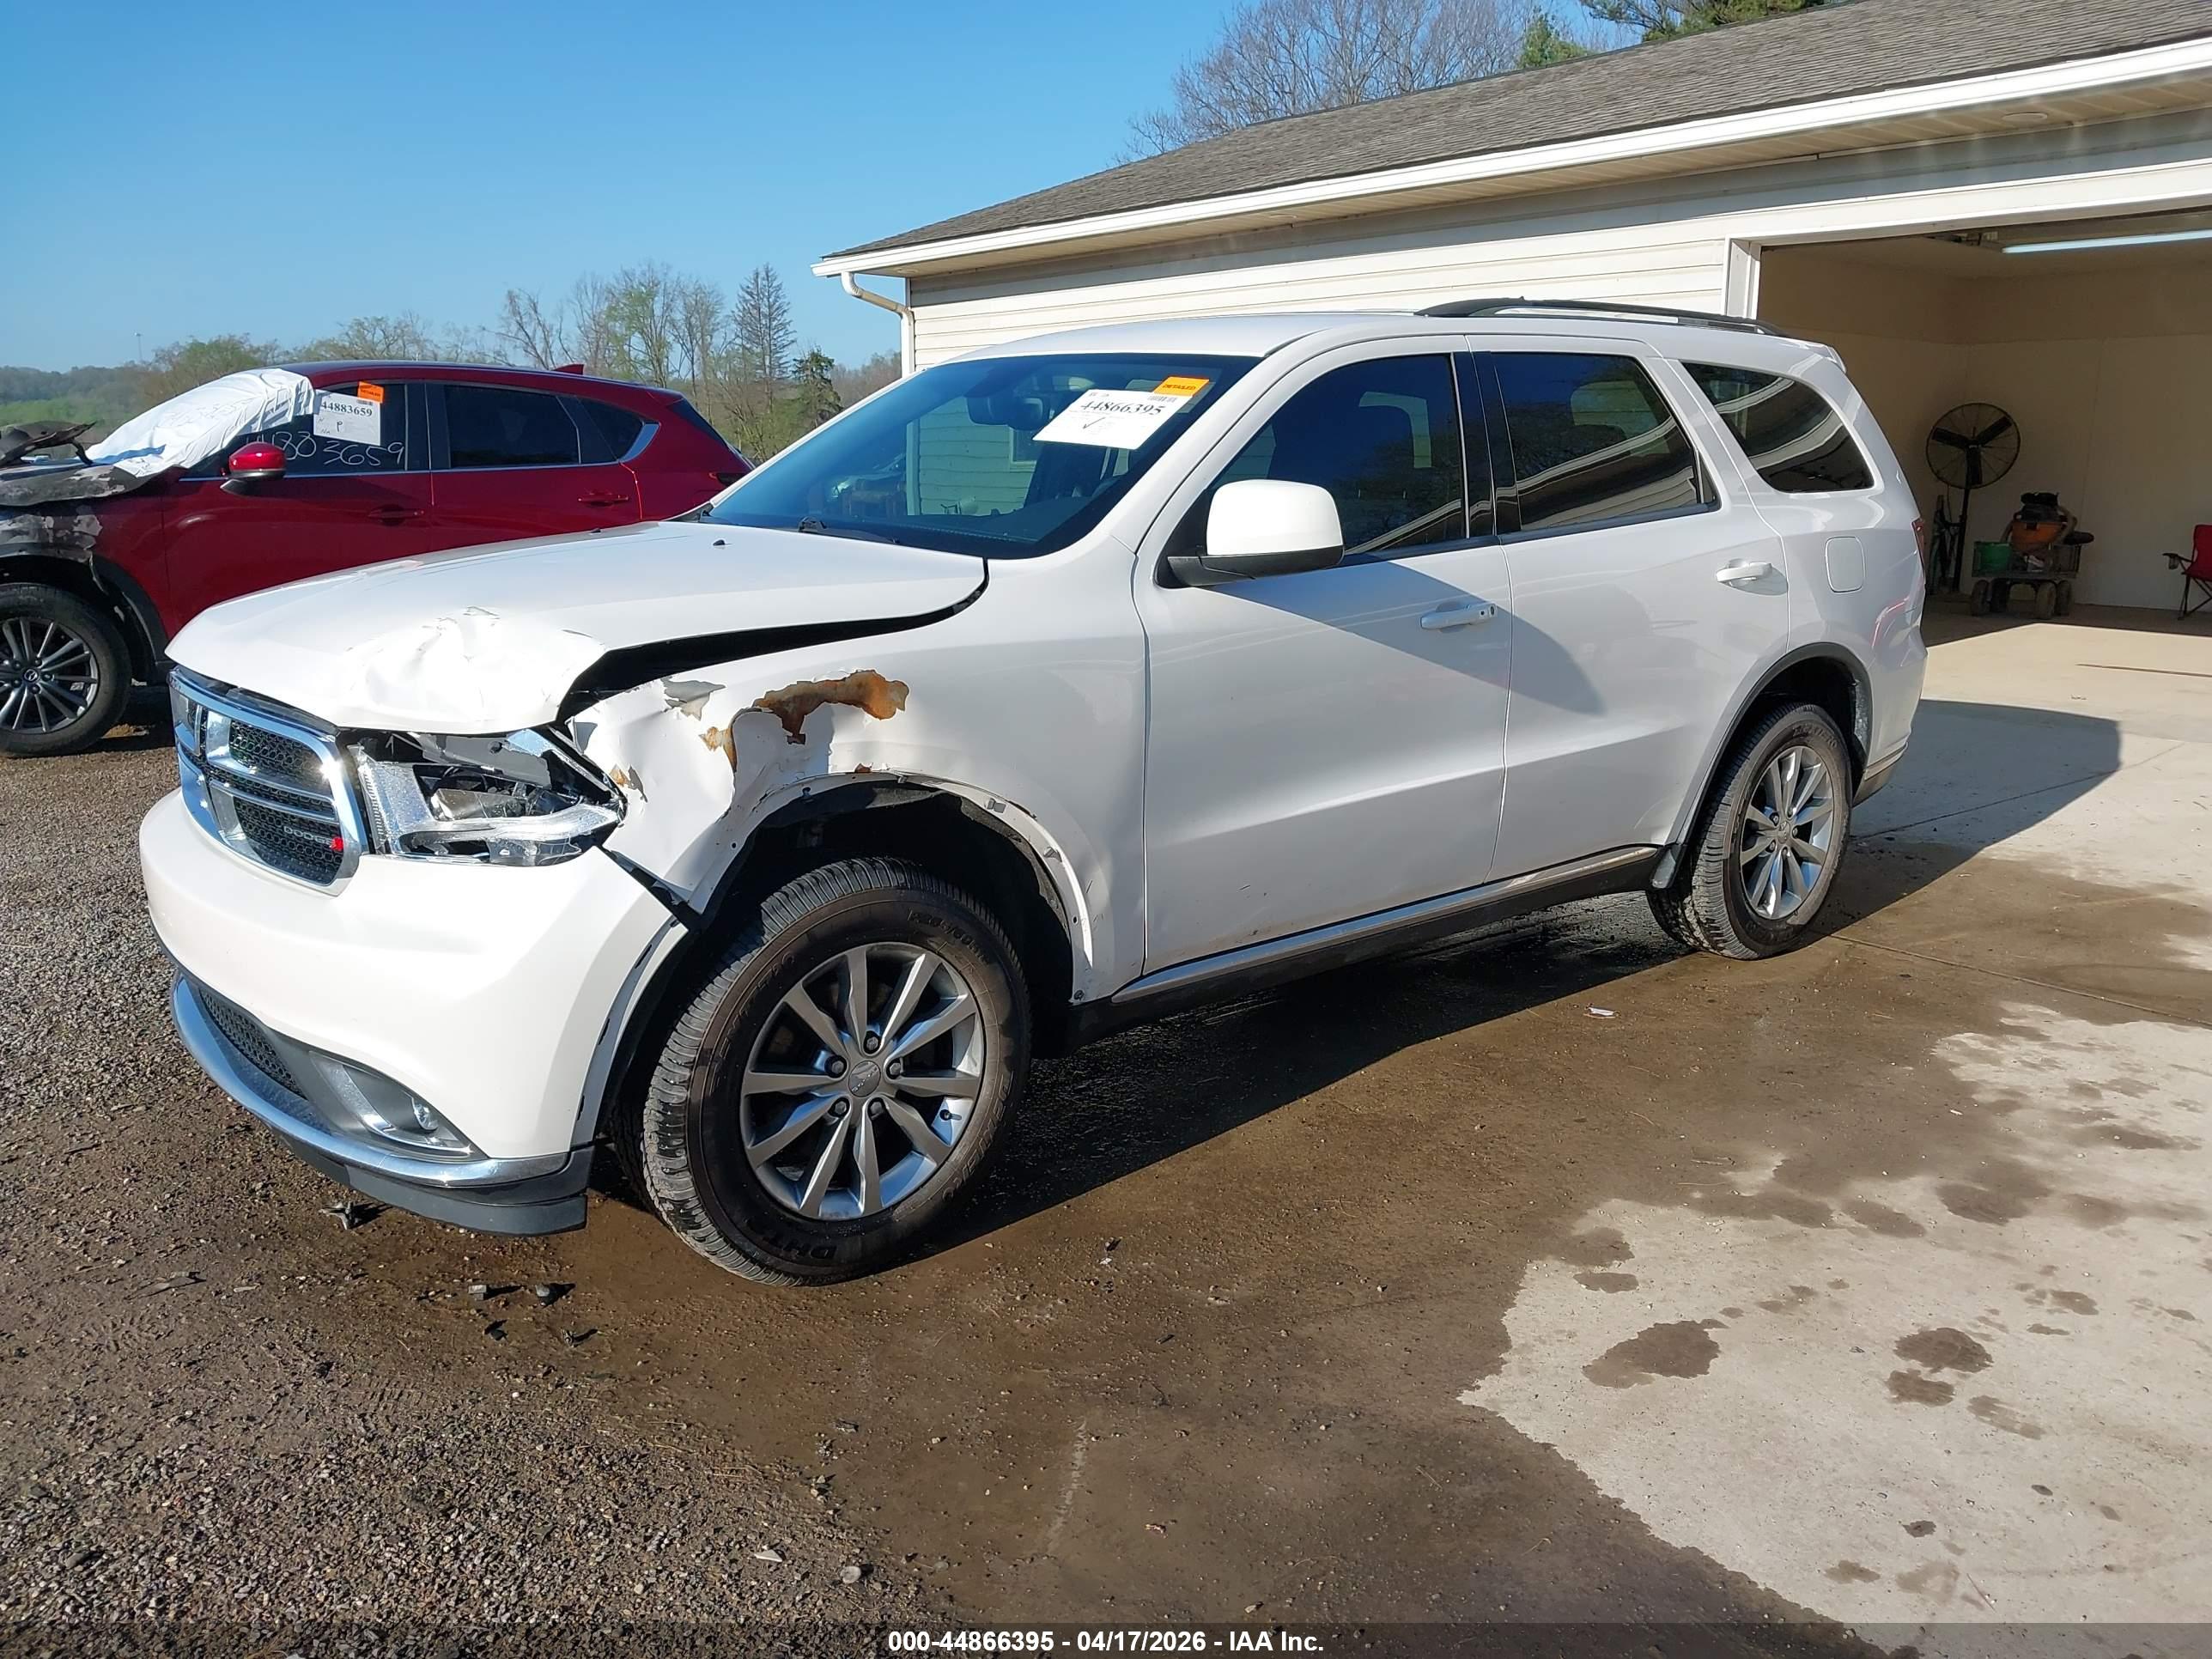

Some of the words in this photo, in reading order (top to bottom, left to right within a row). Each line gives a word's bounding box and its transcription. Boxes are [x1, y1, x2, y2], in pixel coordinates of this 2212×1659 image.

[321, 401, 373, 417] 44883659
[1080, 400, 1166, 416] 44866395
[246, 431, 404, 466] 883659
[283, 825, 332, 845] DODGE
